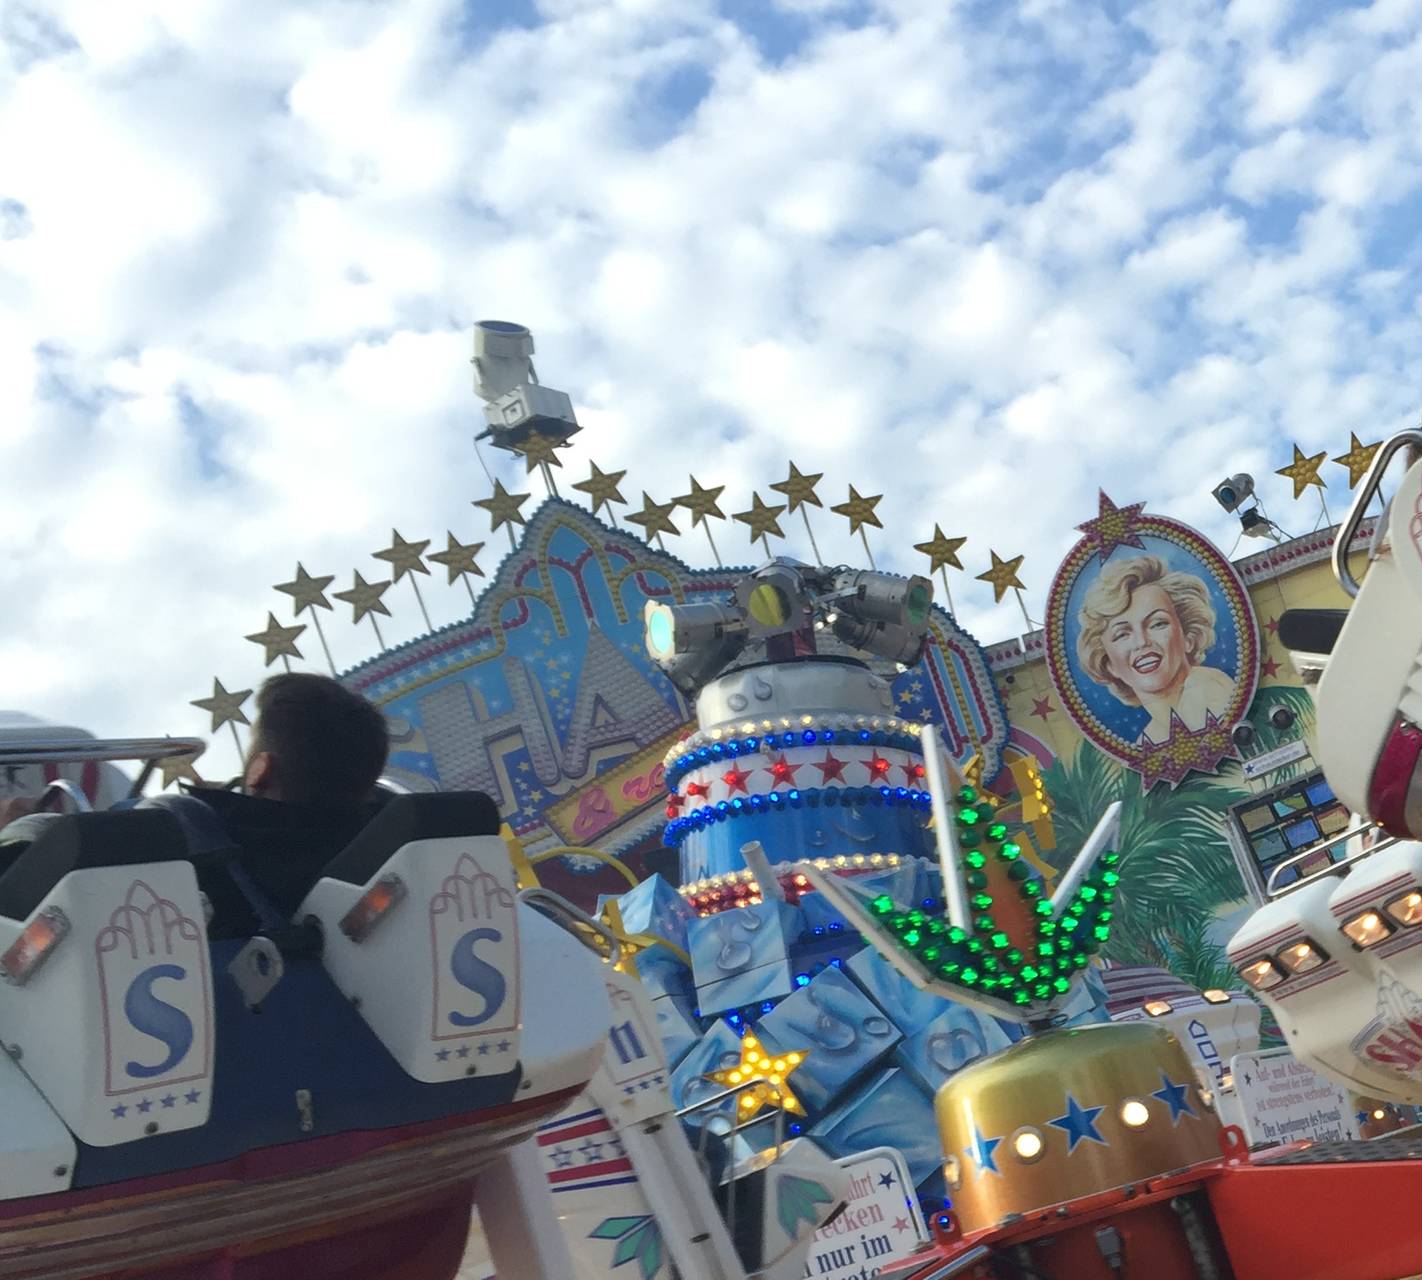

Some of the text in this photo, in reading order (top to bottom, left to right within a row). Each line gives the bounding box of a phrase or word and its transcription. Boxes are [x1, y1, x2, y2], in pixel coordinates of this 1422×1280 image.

[447, 927, 507, 1027] S
[124, 963, 194, 1079] S
[609, 1020, 647, 1065] 11
[816, 1244, 856, 1274] nur
[861, 1233, 893, 1259] im
